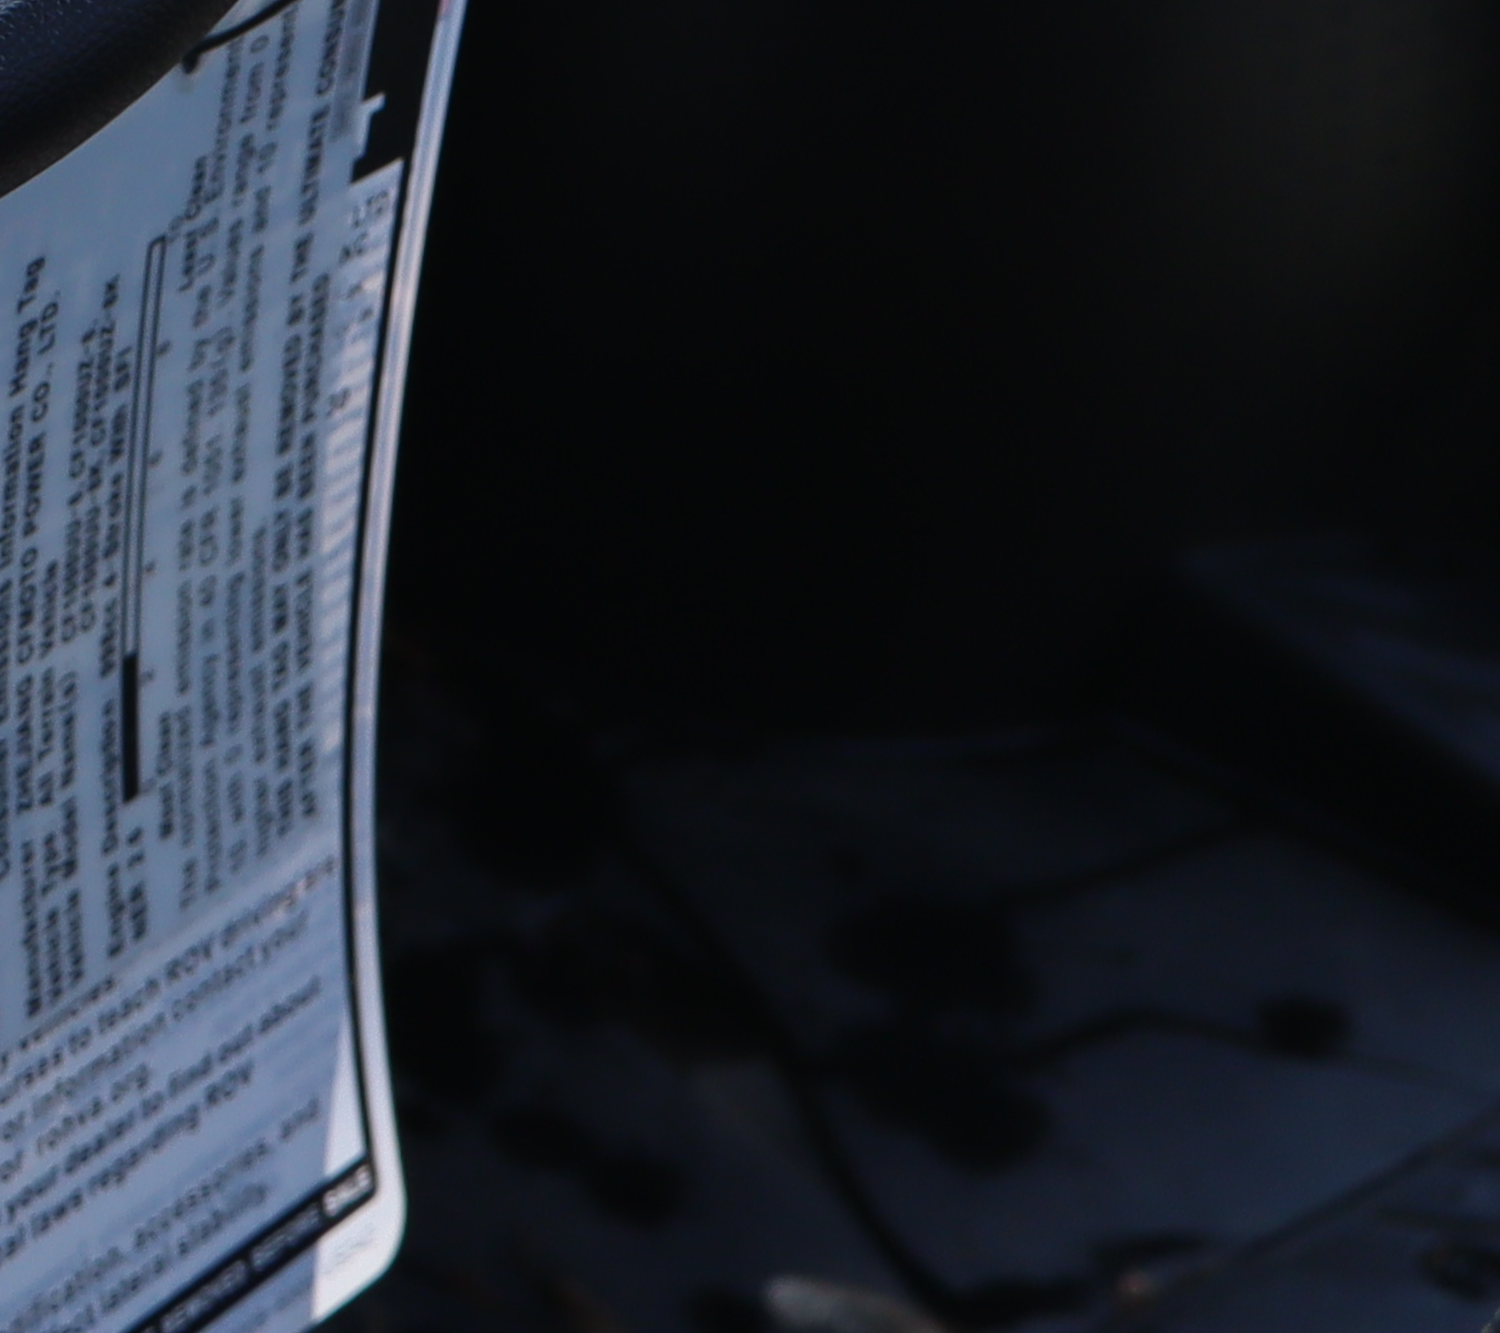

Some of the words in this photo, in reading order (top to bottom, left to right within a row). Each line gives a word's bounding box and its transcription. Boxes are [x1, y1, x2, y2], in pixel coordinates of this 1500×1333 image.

[15, 255, 46, 315] Tag
[8, 318, 38, 397] Hang
[21, 432, 45, 537] POWER
[16, 546, 38, 664] CFMOTO
[39, 561, 57, 658] Vehicle
[37, 667, 54, 761] Terrain
[164, 936, 212, 981] ROV
[204, 1063, 253, 1108] ROV
